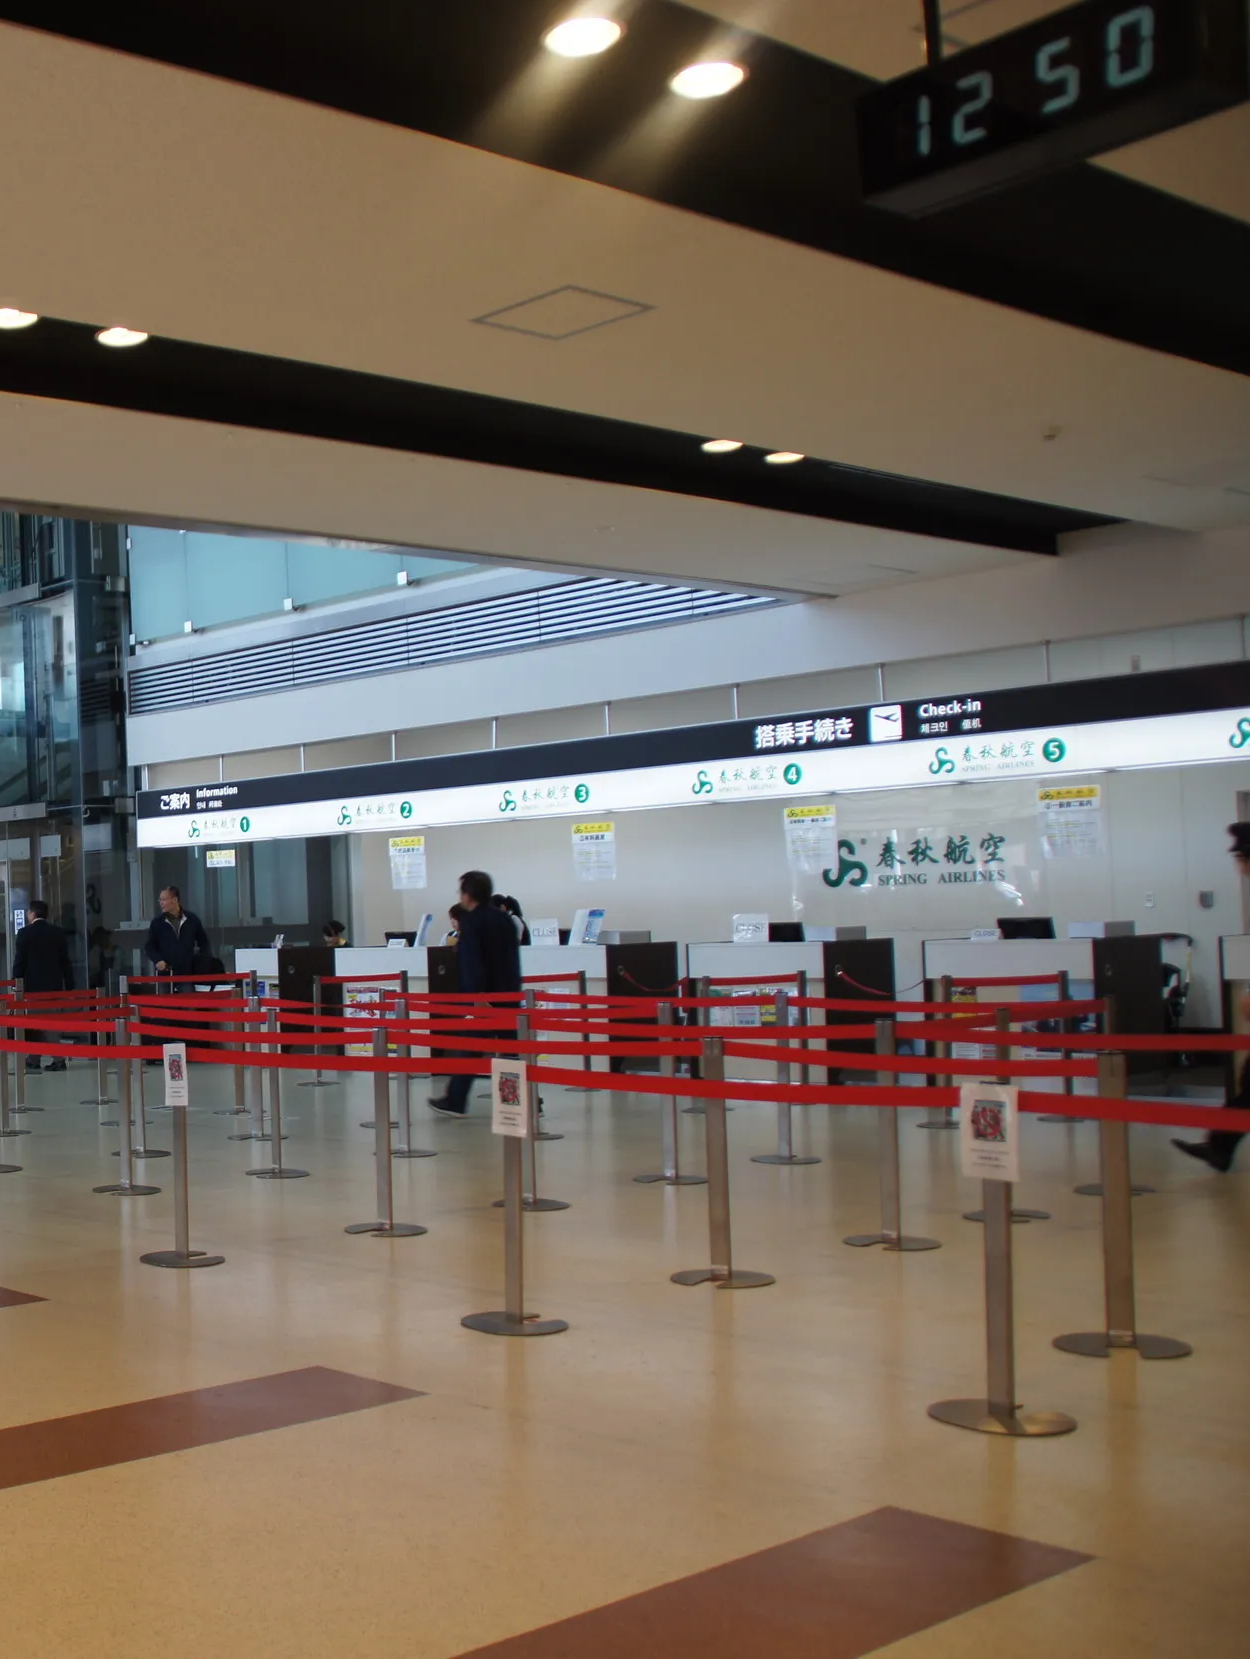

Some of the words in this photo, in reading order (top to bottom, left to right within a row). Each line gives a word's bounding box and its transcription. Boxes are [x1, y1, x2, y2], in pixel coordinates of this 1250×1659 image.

[917, 70, 993, 156] 12
[1034, 5, 1155, 114] 50
[919, 699, 982, 718] Check-in
[755, 717, 854, 749] 搭乗手続き
[920, 720, 949, 734] 체크인
[962, 740, 1036, 762] 春秋航空
[718, 764, 778, 783] 春秋航空
[961, 764, 991, 773] SPRING
[996, 761, 1036, 770] AIRLINES
[196, 785, 238, 798] Information
[160, 792, 190, 811] ご案内
[876, 832, 1007, 869] 春秋航空
[878, 872, 928, 887] SPRING
[937, 869, 1007, 885] AIRLINES
